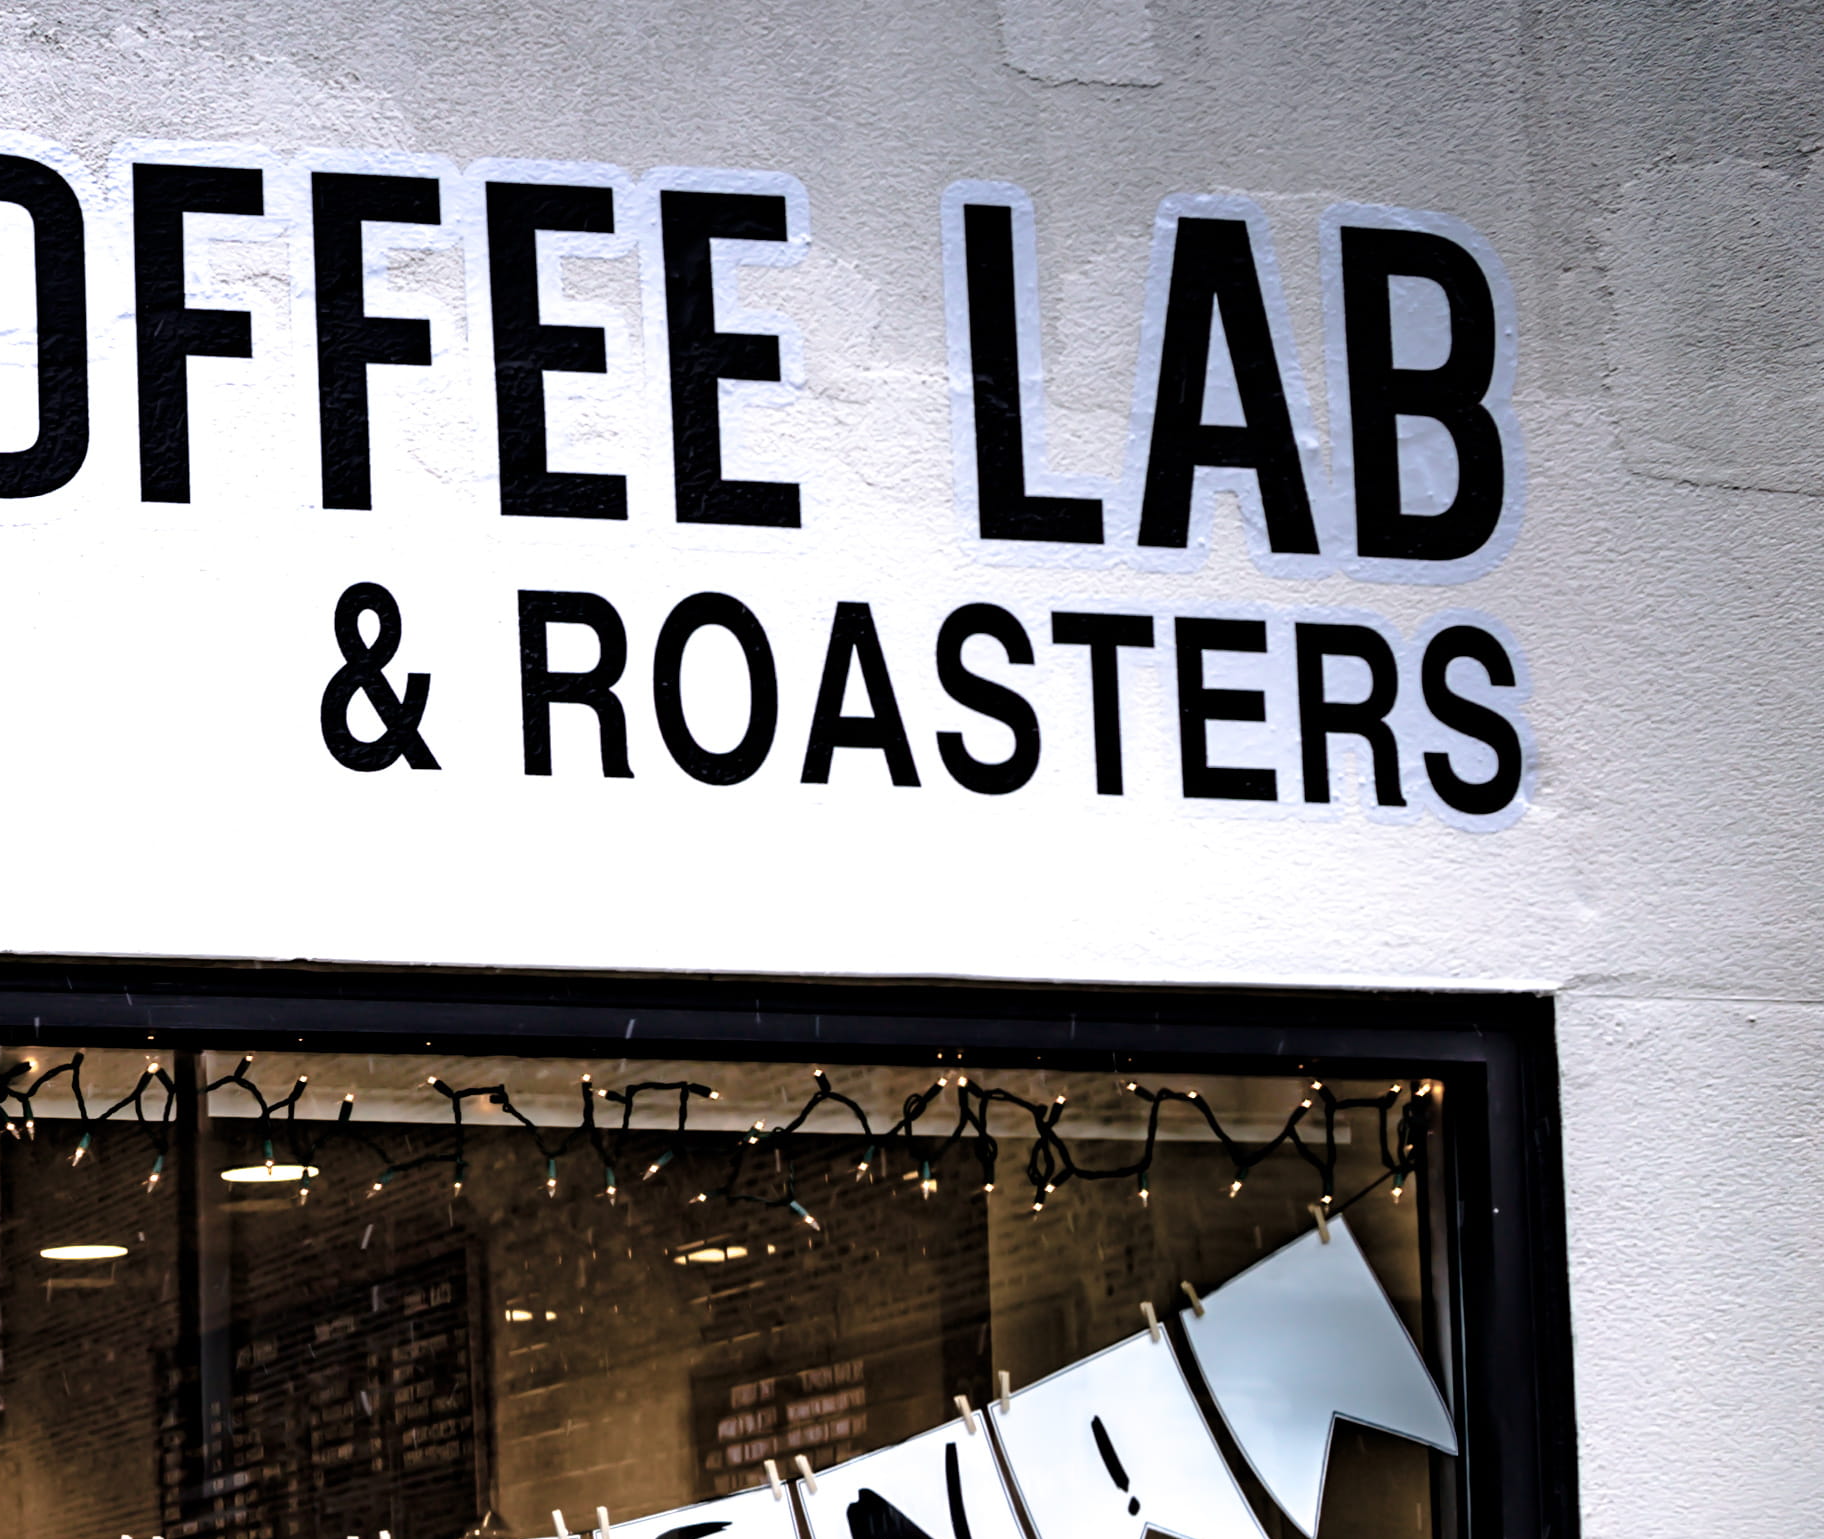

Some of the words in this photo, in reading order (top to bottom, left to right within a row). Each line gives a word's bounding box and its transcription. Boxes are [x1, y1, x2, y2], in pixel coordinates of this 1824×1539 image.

[964, 204, 1503, 560] LAB
[321, 583, 441, 771] &
[518, 590, 1521, 814] ROASTERS
